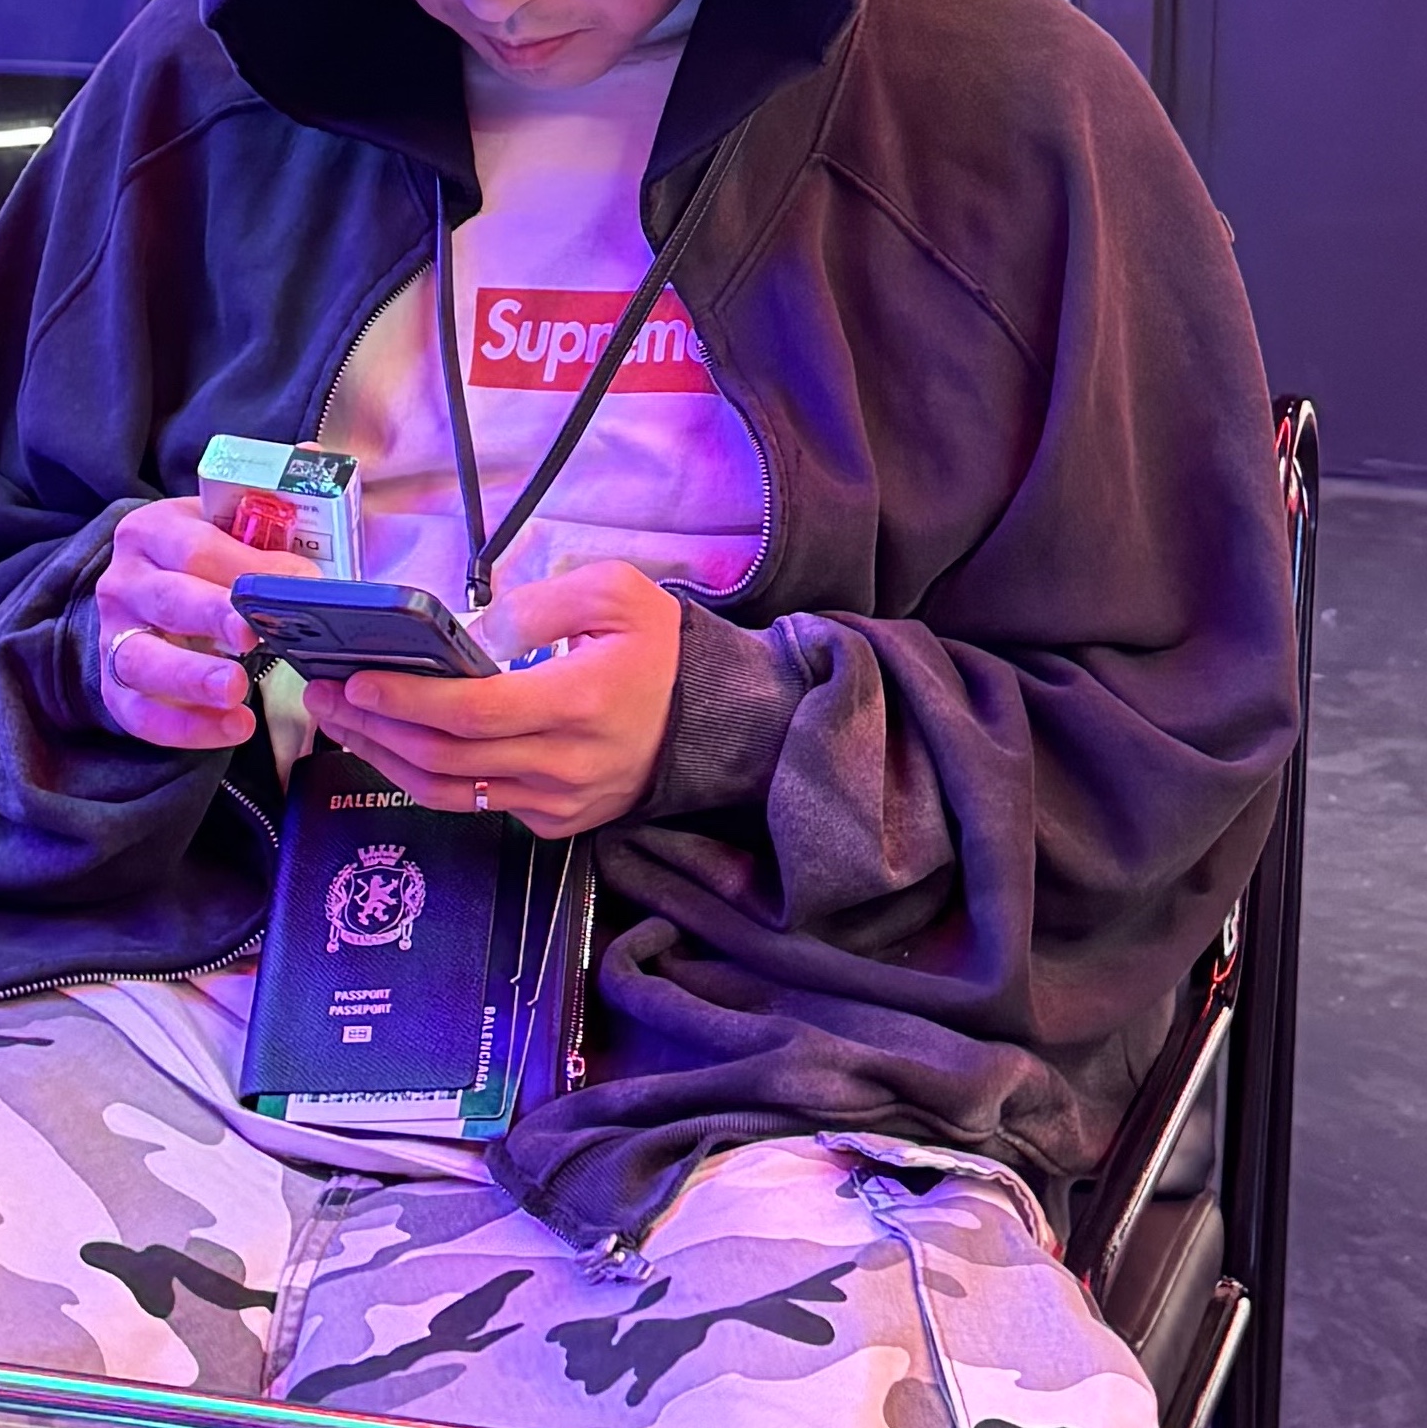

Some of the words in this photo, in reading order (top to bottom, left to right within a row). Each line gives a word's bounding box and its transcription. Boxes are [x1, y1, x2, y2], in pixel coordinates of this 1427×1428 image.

[480, 298, 703, 383] Suprm
[329, 1003, 392, 1016] PASSEPORT
[334, 988, 392, 1003] PASSPORT
[473, 1005, 497, 1093] BALENCIAGA
